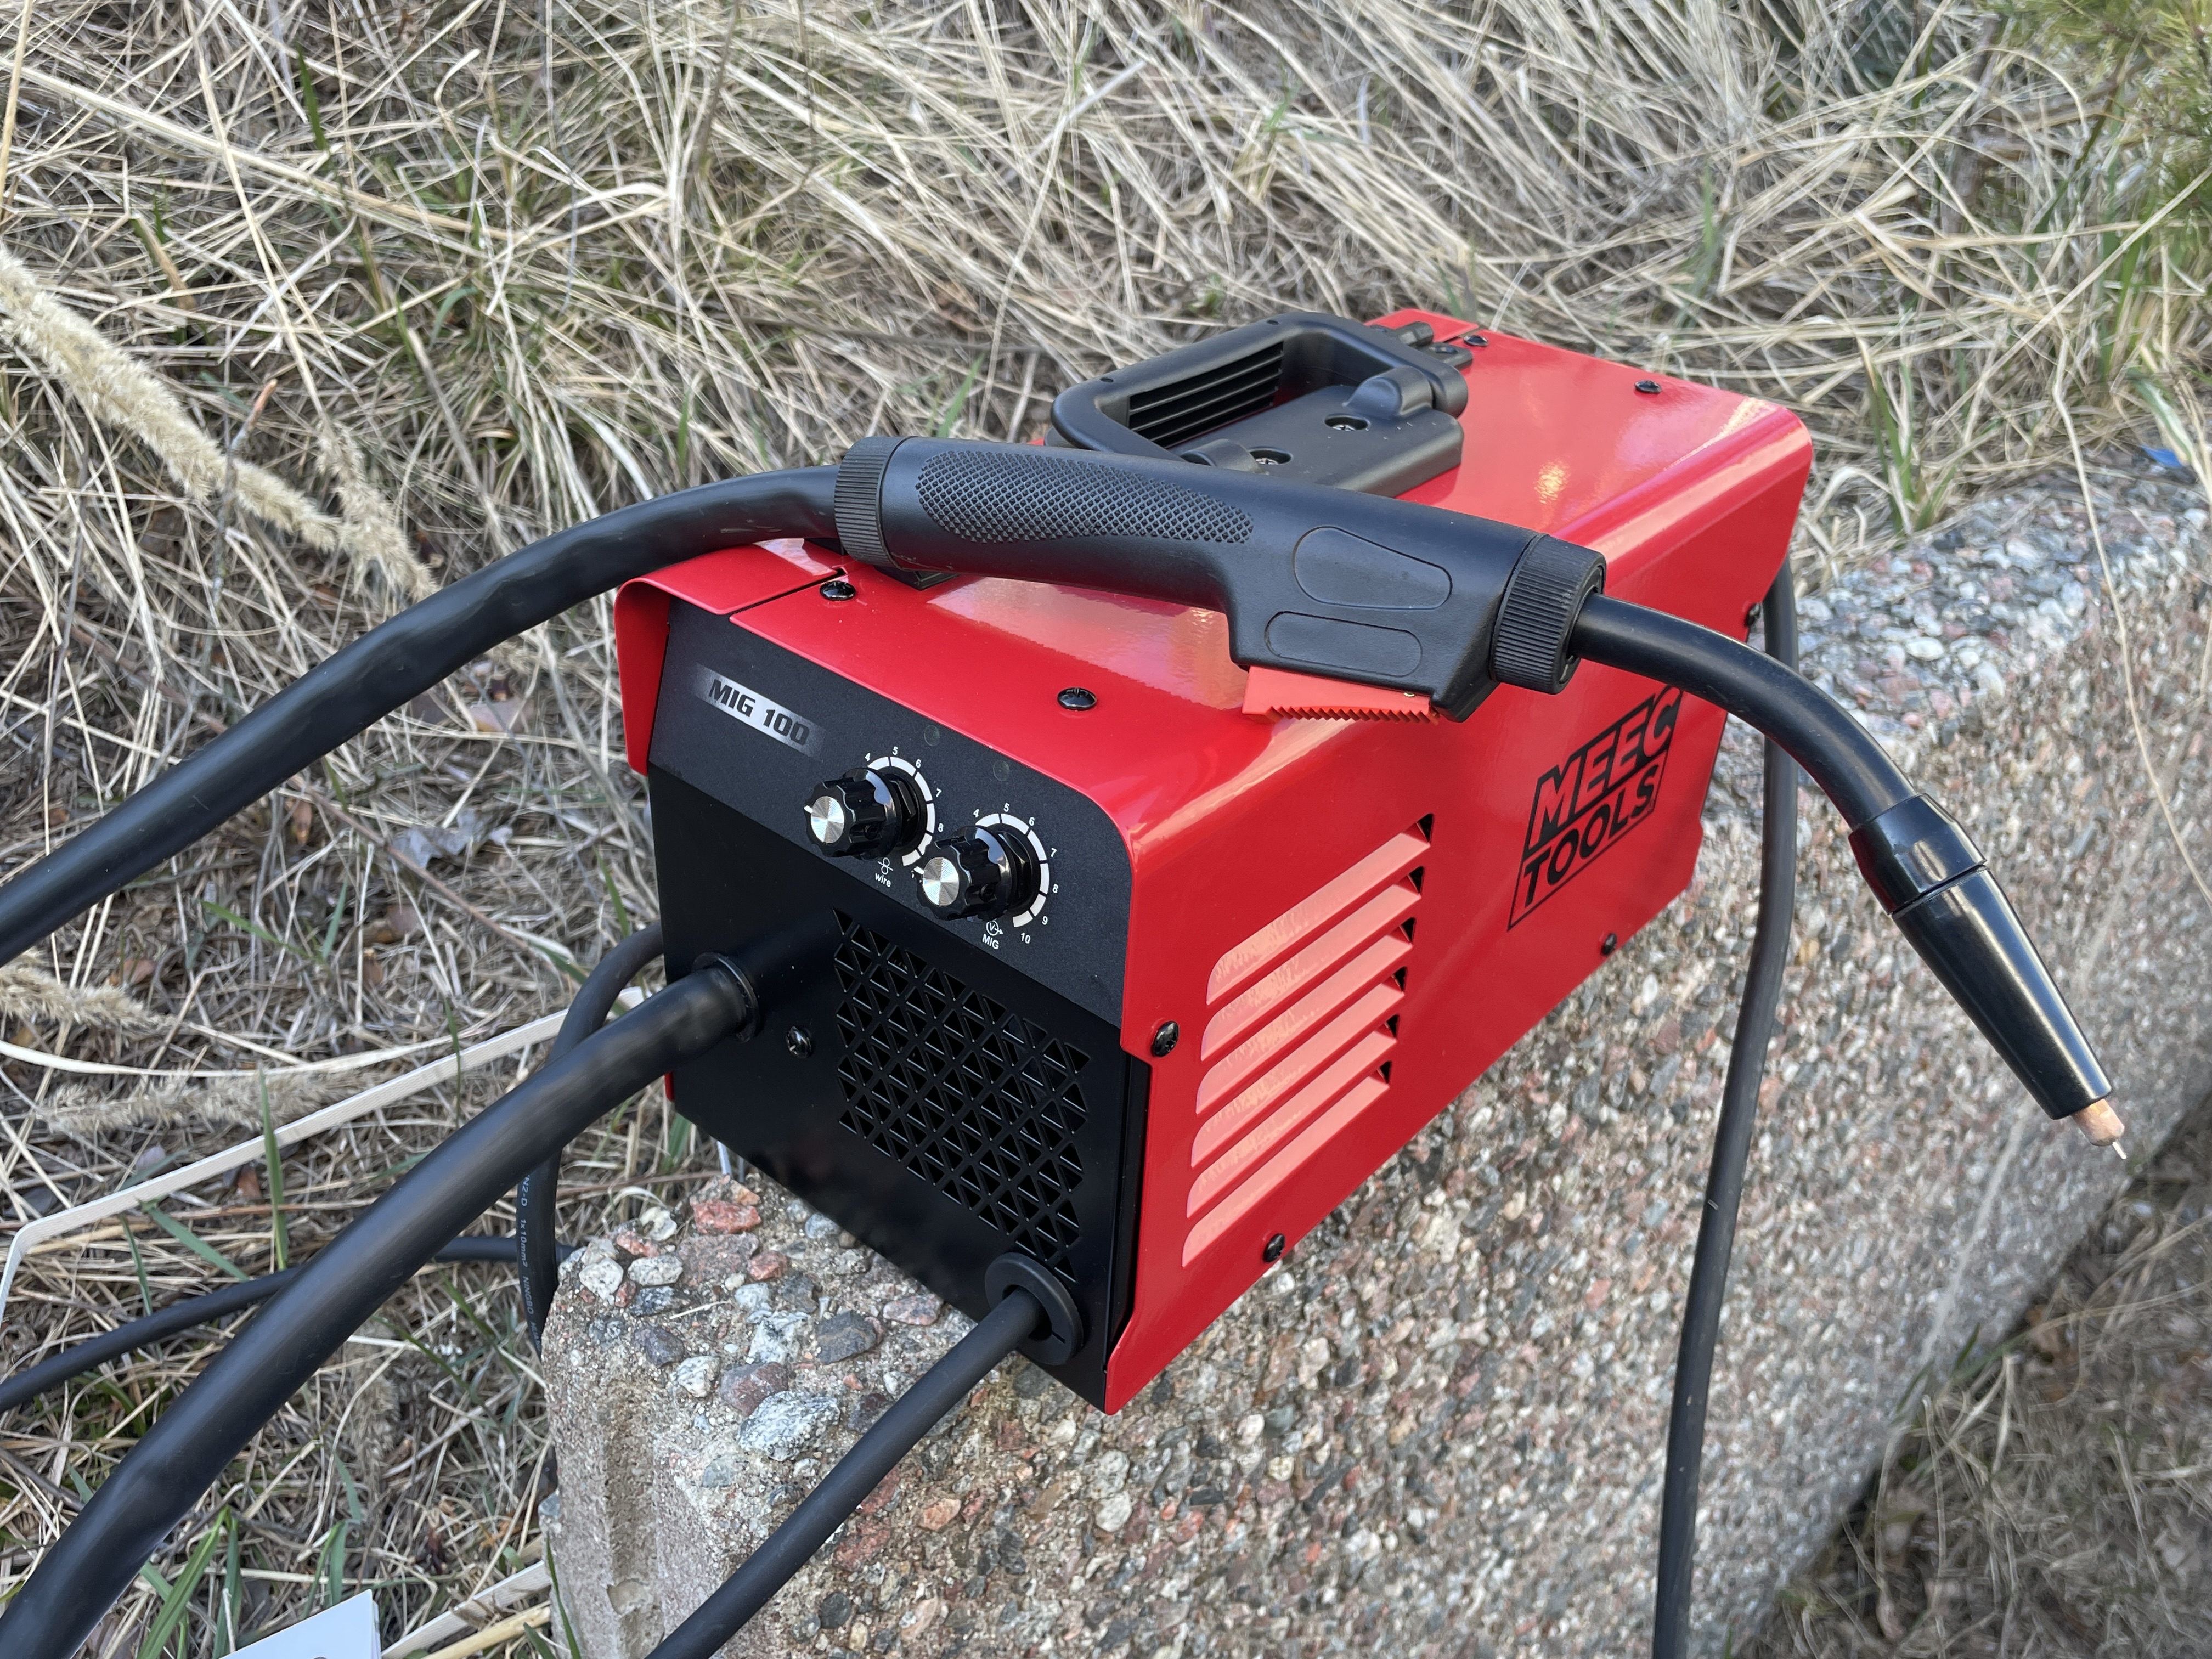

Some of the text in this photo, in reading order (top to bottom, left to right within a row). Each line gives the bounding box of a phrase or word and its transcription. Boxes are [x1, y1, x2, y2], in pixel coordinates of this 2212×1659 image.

[709, 679, 810, 746] MIG 100
[865, 746, 944, 832] 4 5 6 7 8
[1525, 685, 1682, 856] MEEC
[1524, 764, 1658, 907] TOOLS
[875, 873, 891, 887] wire
[973, 803, 1058, 944] 4 5 6 7 8 9 10
[982, 934, 999, 950] MIG
[521, 1175, 530, 1206] N2-D
[523, 1276, 534, 1314] NINGBO
